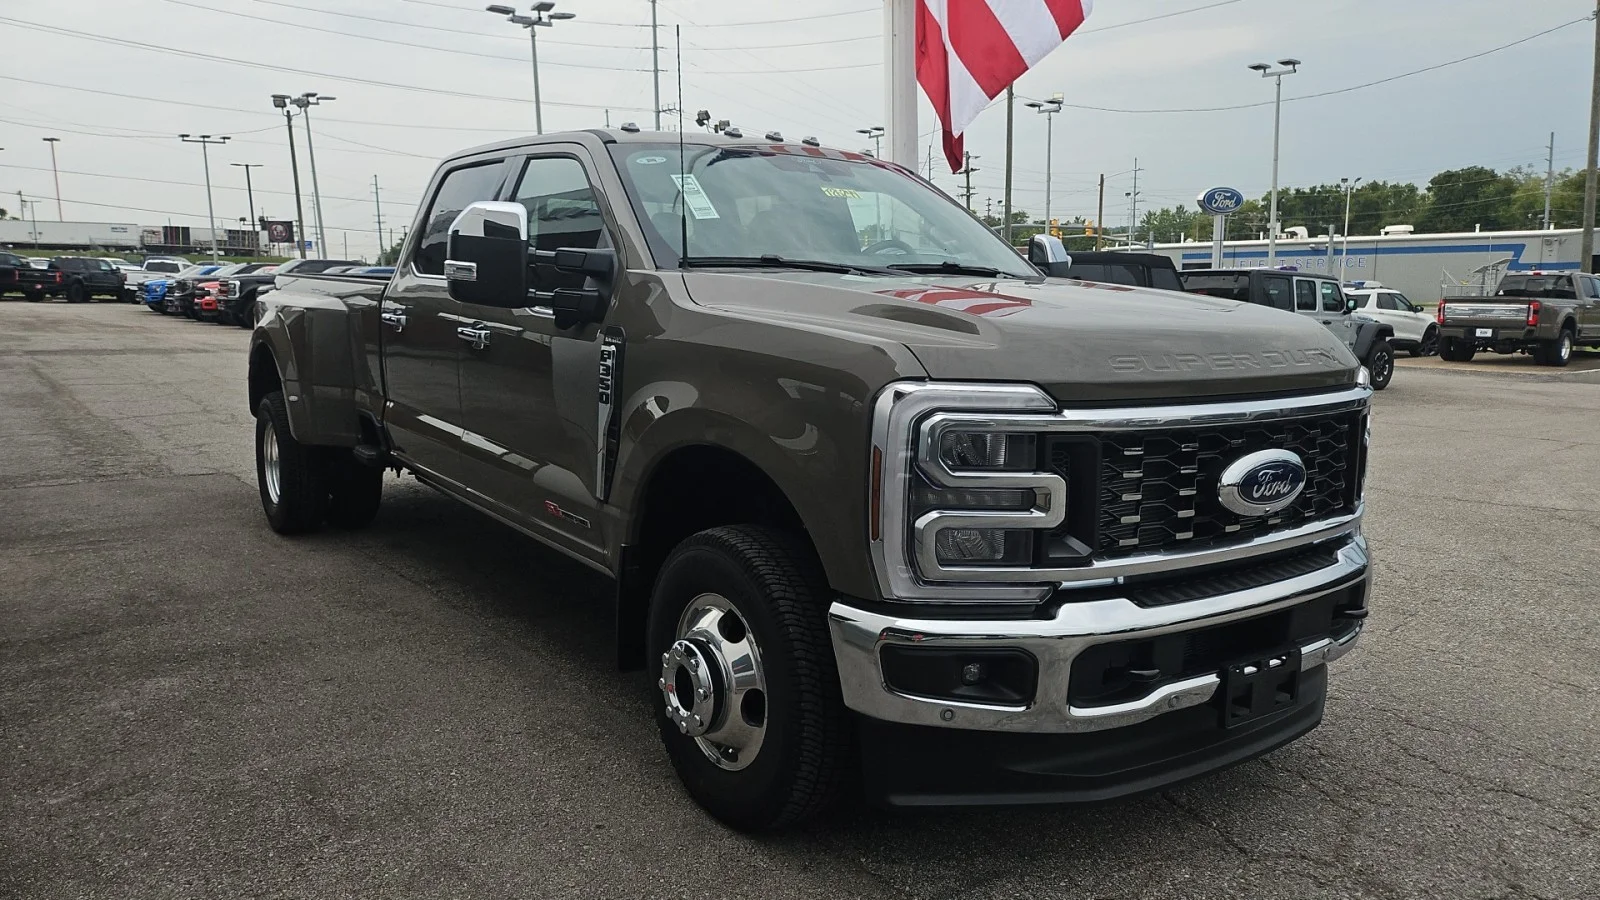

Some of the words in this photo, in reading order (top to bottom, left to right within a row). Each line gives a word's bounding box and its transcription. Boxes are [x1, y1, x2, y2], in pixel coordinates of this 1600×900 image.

[1212, 192, 1237, 208] Ford
[1240, 259, 1287, 268] FLET
[1108, 351, 1261, 373] SUPER
[1252, 468, 1293, 498] Ford
